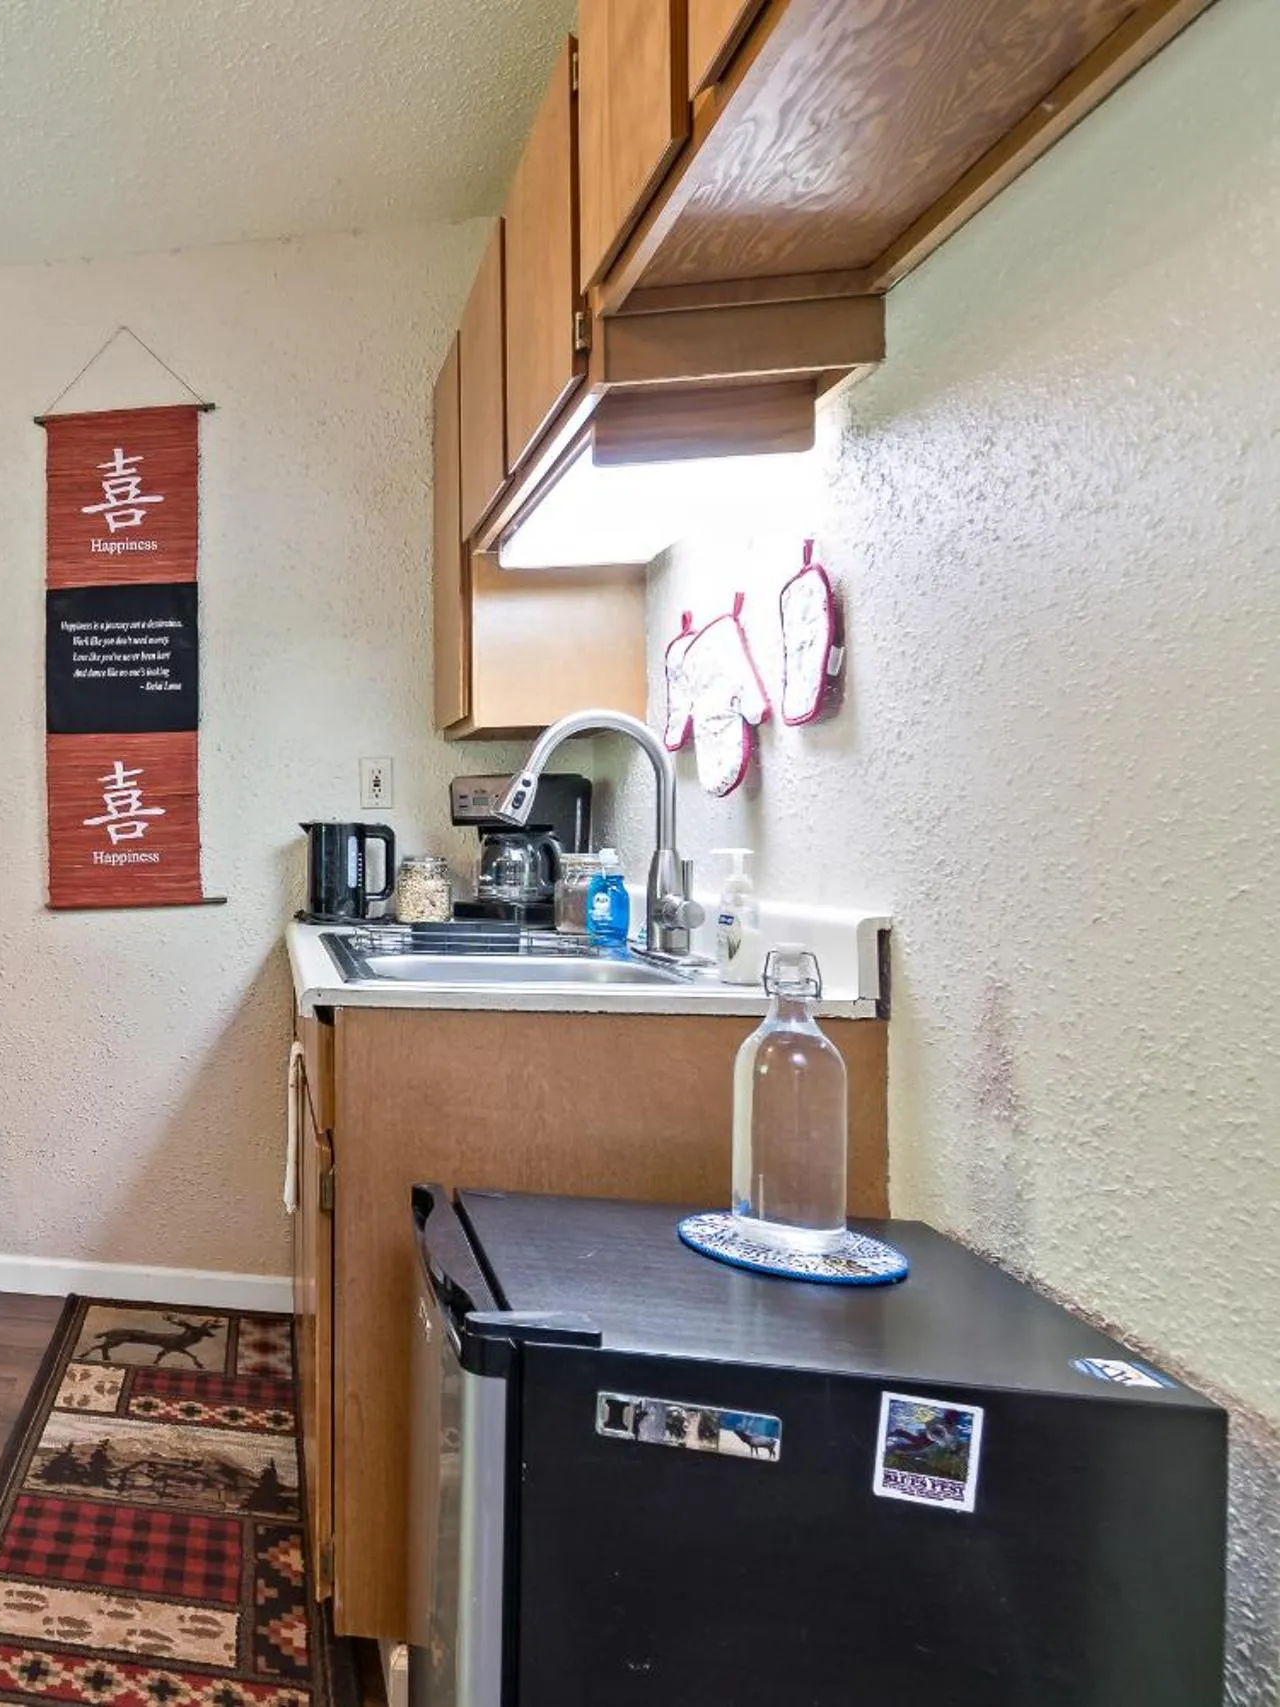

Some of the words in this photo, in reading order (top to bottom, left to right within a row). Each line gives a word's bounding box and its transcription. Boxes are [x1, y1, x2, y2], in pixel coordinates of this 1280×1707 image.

[81, 448, 164, 533] 喜
[91, 537, 158, 554] Happiness
[61, 621, 92, 632] Happiness
[104, 622, 129, 632] journey
[90, 636, 102, 646] like
[102, 638, 115, 648] you
[133, 635, 149, 645] need
[73, 652, 88, 662] Love
[141, 651, 156, 661] been
[83, 761, 166, 845] 喜
[93, 850, 160, 866] Happiness
